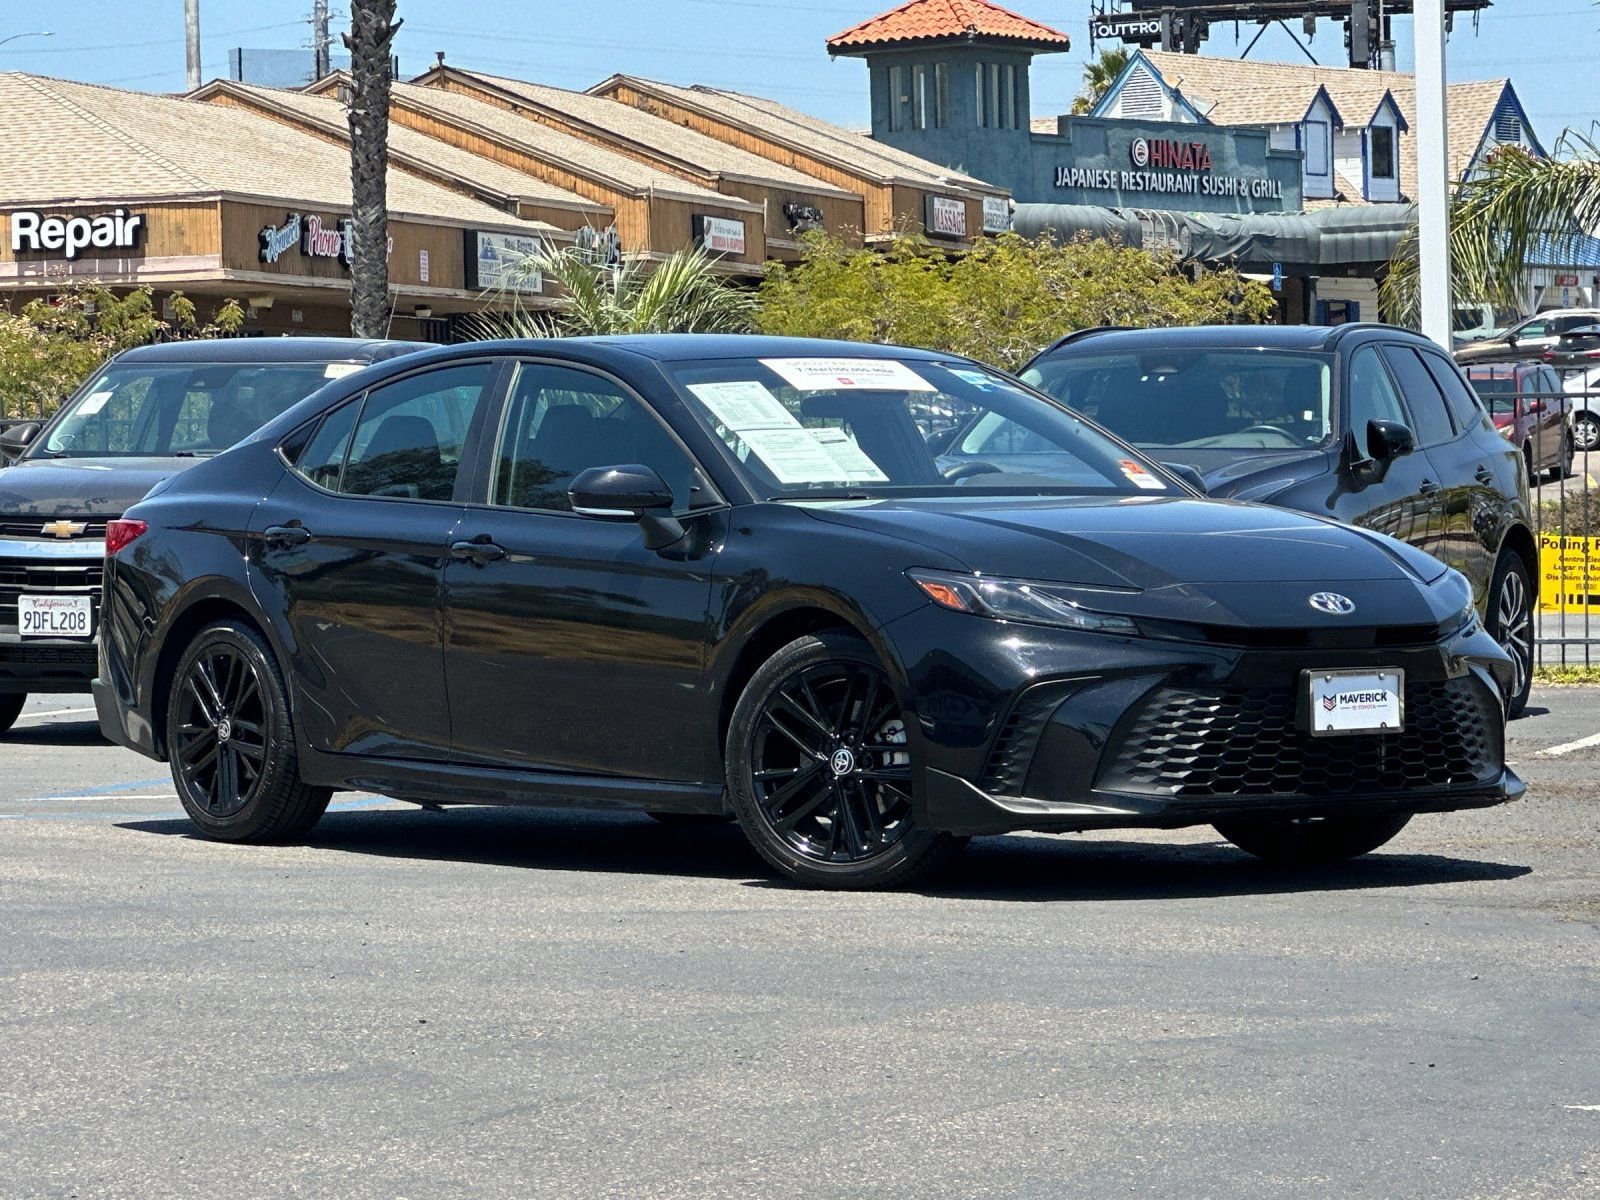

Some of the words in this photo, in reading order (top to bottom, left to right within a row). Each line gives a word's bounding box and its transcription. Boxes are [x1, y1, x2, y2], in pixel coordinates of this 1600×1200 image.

[1098, 21, 1162, 37] OUTFRO
[1151, 139, 1212, 170] HINATA
[1055, 166, 1117, 190] JAPANESE
[1121, 171, 1198, 194] RESTAURANT
[1202, 176, 1237, 196] SUSHI
[1239, 178, 1248, 197] &
[1251, 179, 1283, 198] GRILL
[11, 208, 140, 258] Repair
[934, 207, 966, 234] MASSAGE
[308, 215, 341, 257] Phone
[34, 599, 75, 610] California
[23, 612, 86, 630] 9DFL208
[1340, 692, 1387, 704] MAVERICK
